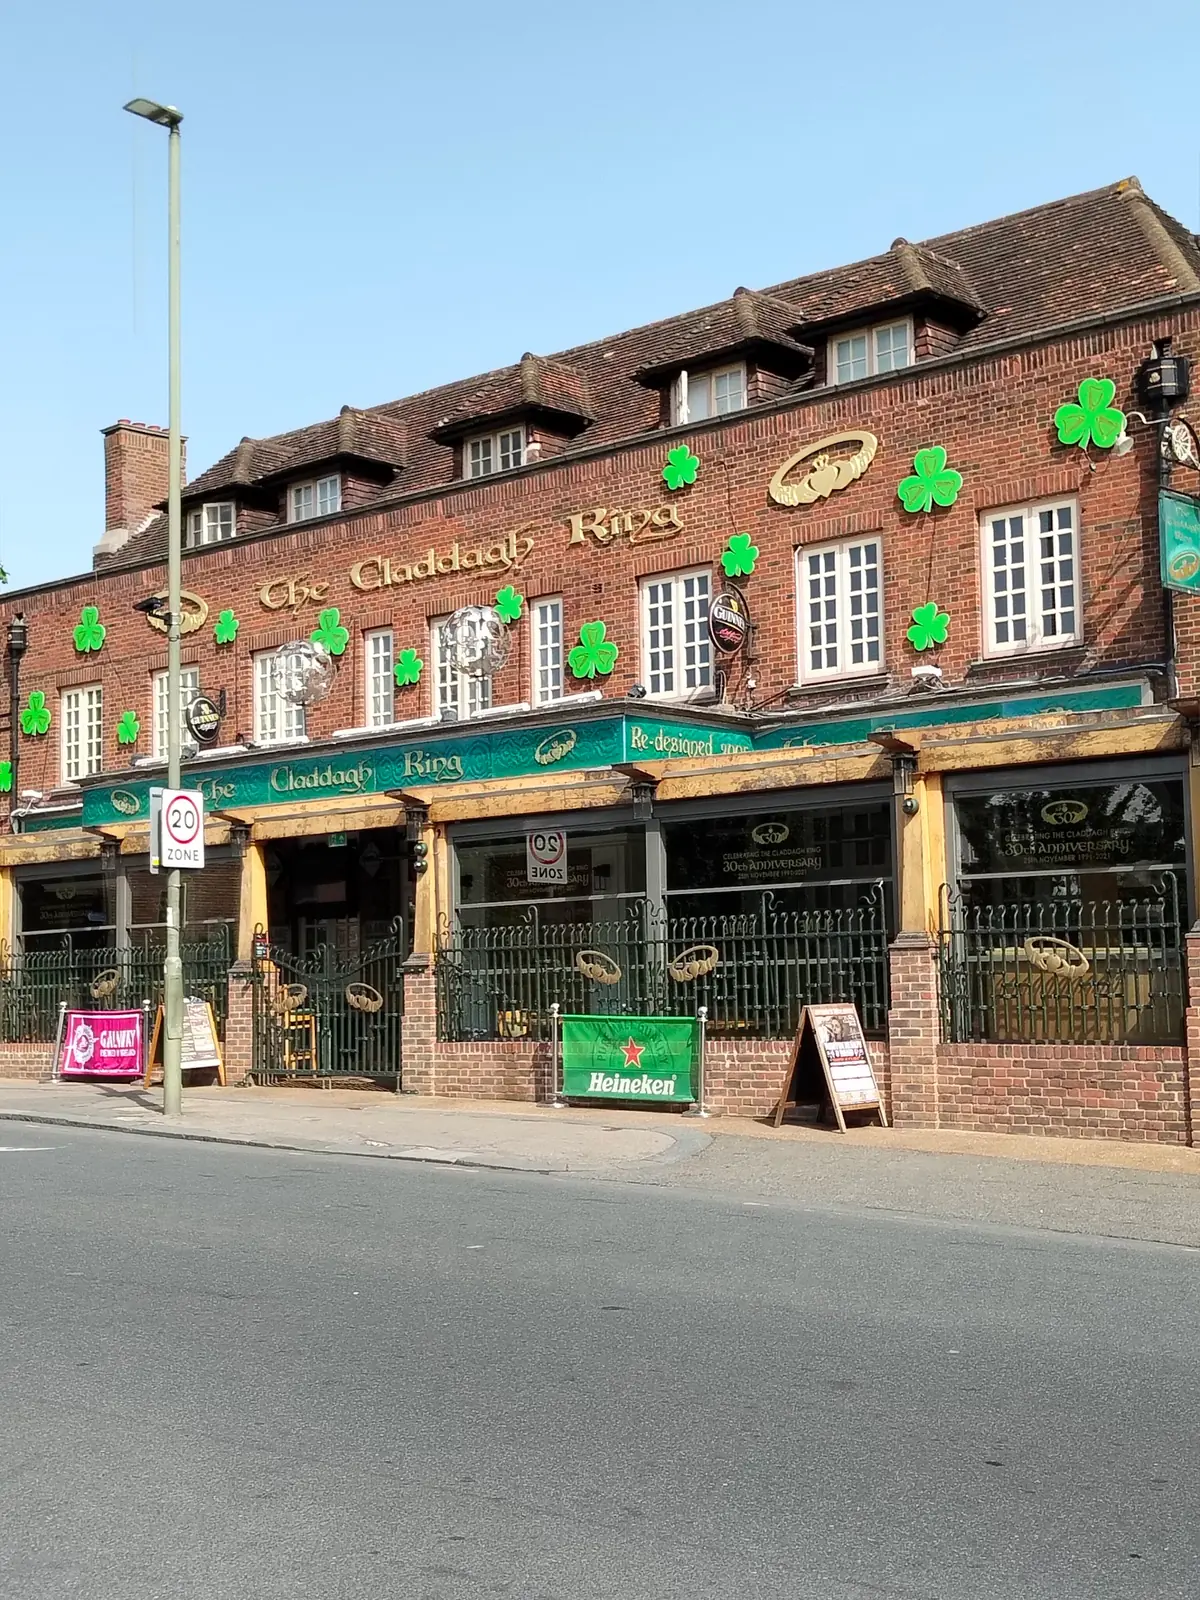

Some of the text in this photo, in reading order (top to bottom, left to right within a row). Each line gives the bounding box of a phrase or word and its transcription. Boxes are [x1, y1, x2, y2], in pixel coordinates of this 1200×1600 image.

[256, 503, 685, 614] The Claddagh Ring
[714, 606, 745, 631] GUINNE
[630, 725, 713, 759] Re-designed
[196, 750, 464, 807] The Claddagh Ring
[172, 810, 195, 829] 20
[1052, 831, 1065, 839] THE
[1066, 829, 1108, 838] CLADDAGH
[167, 849, 199, 862] ZONE
[1038, 839, 1129, 854] ANNIVERSARY
[749, 857, 822, 870] ANNIVERSARY
[1040, 854, 1075, 863] NOVEMBER
[100, 1029, 136, 1048] GALWAY
[587, 1071, 675, 1095] Heineken
